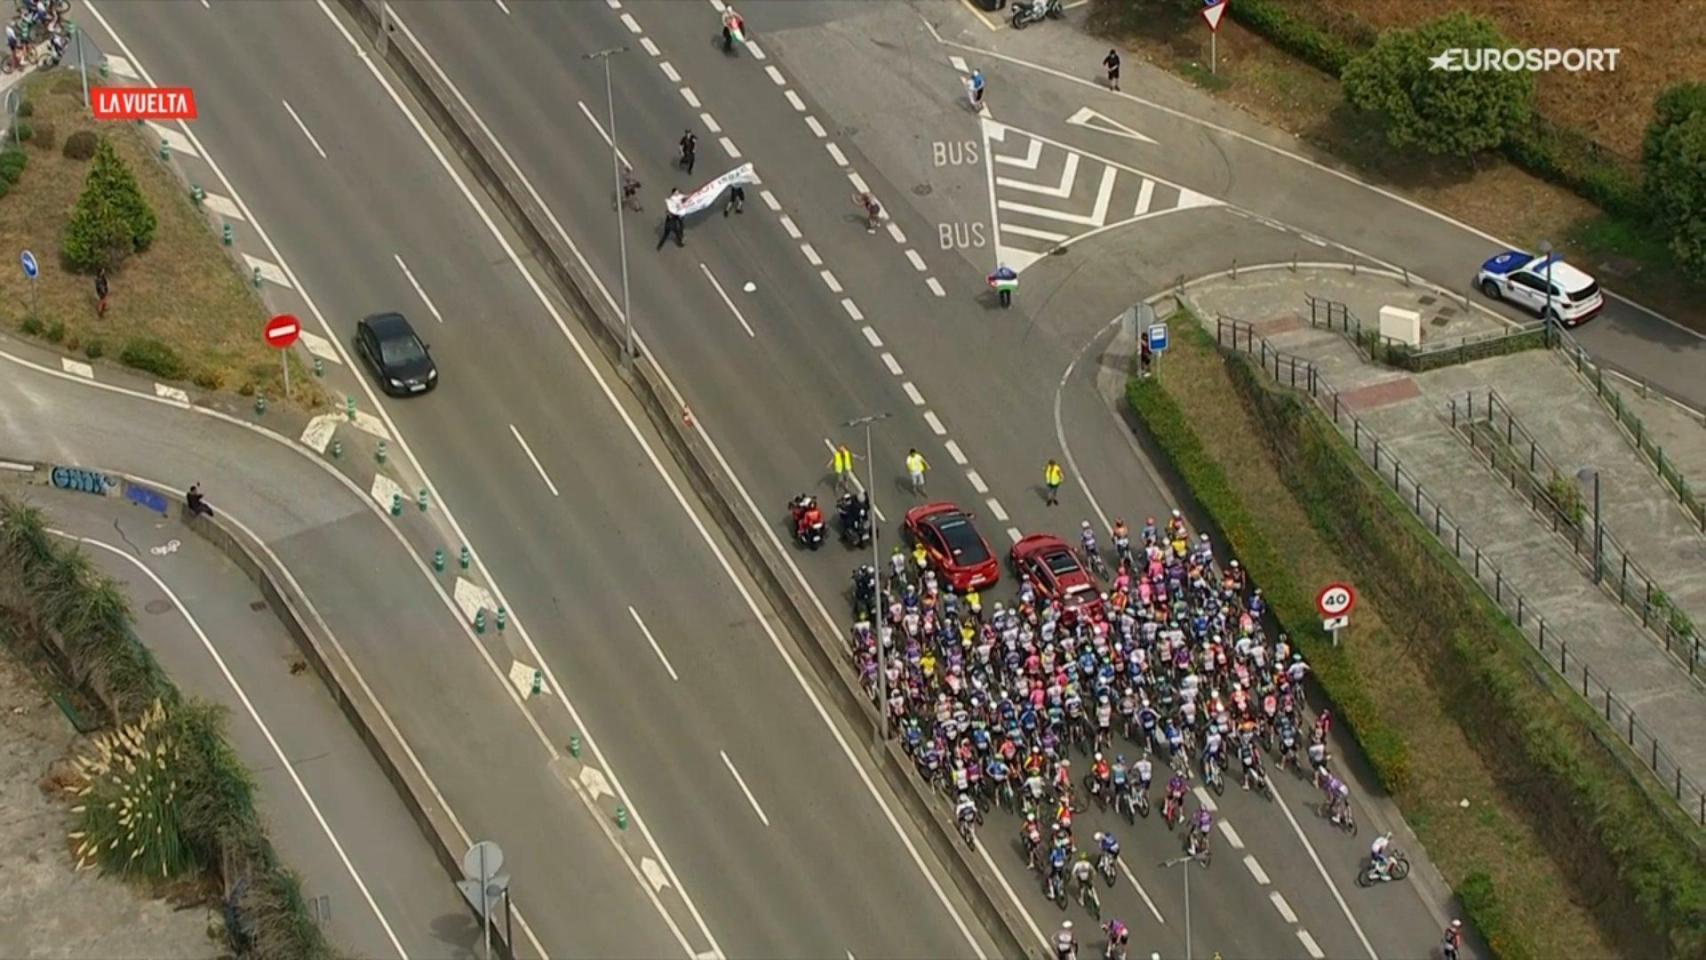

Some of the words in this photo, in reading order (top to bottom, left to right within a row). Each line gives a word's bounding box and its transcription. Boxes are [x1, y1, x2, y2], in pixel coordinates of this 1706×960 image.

[933, 141, 979, 167] BUS
[939, 222, 986, 250] BUS
[1325, 593, 1347, 606] 40
